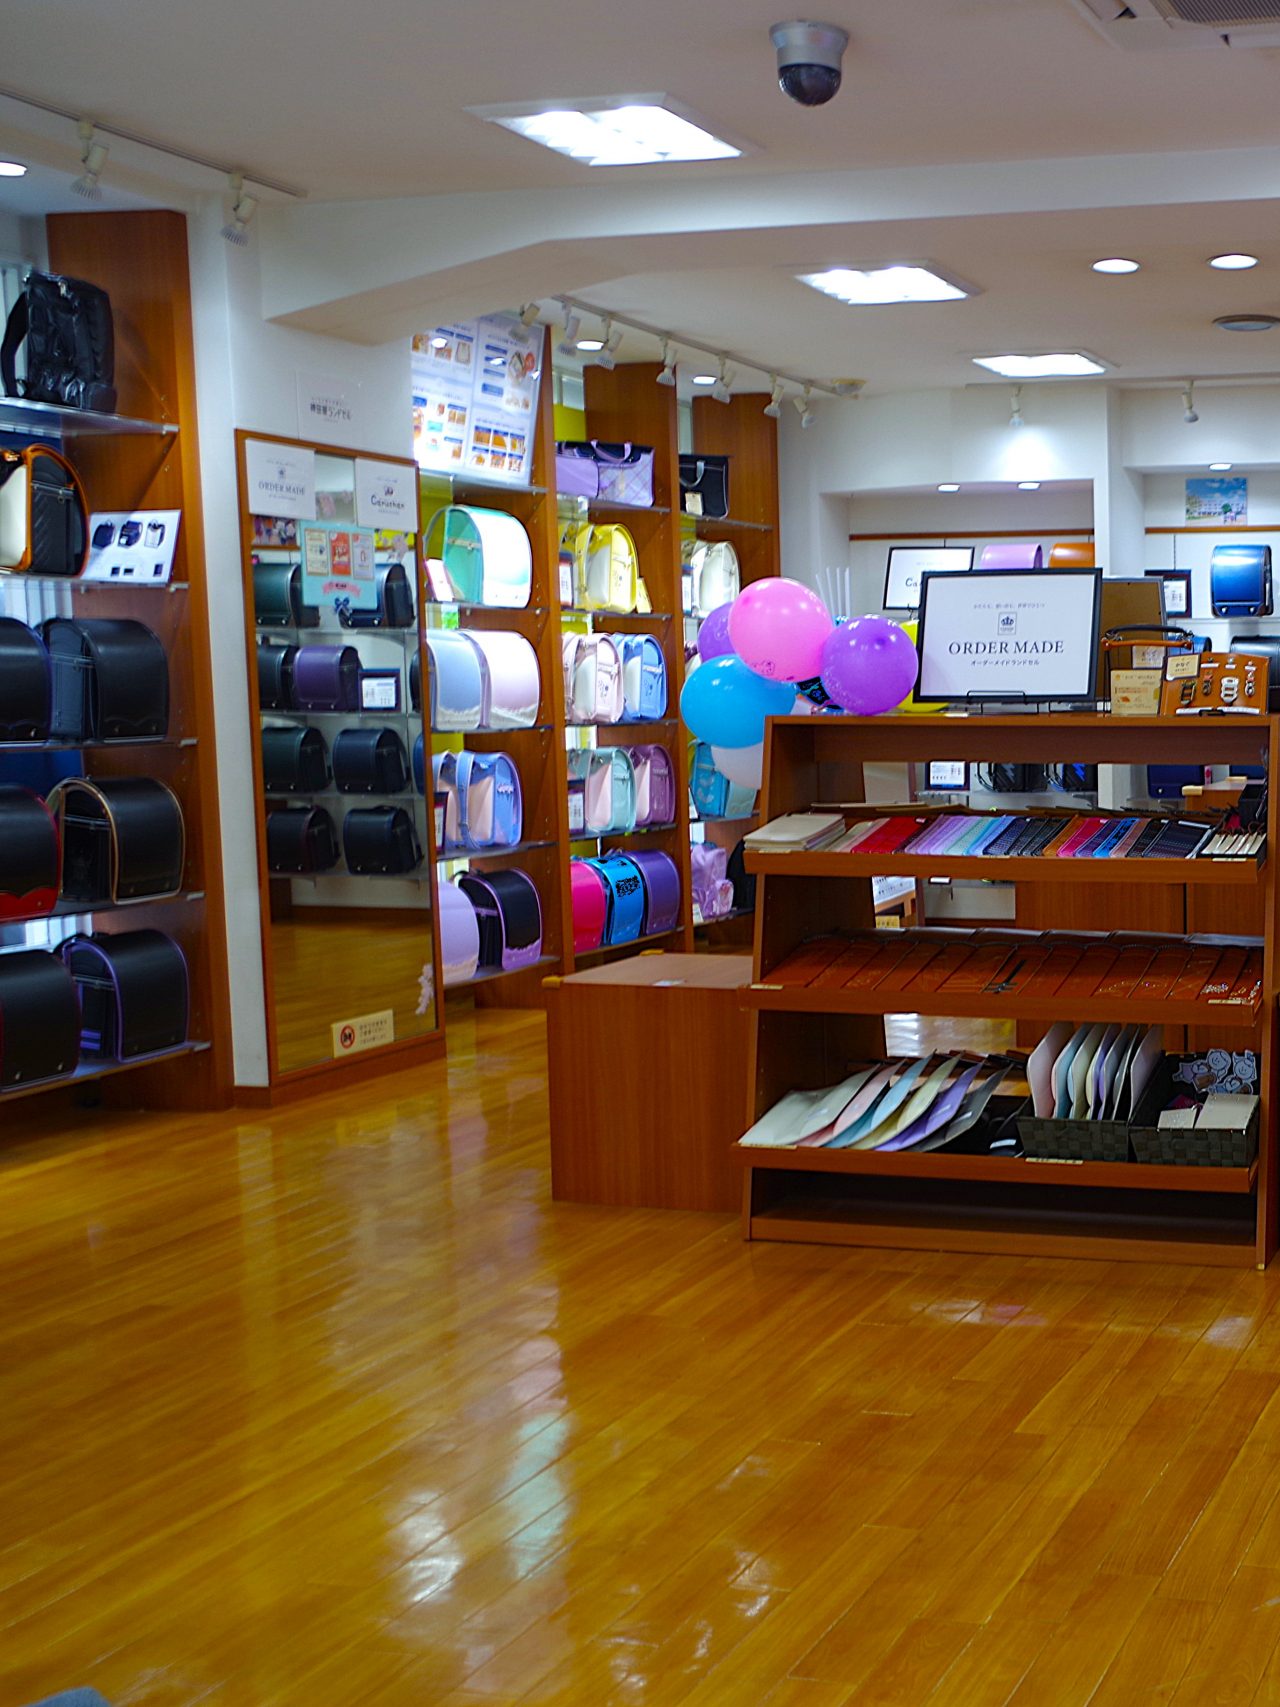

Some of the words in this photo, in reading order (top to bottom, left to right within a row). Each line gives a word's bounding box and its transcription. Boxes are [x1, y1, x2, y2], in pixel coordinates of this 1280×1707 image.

[258, 480, 284, 493] ORDER
[285, 484, 305, 496] MADE
[949, 640, 1009, 655] ORDER
[1014, 640, 1064, 654] MADE
